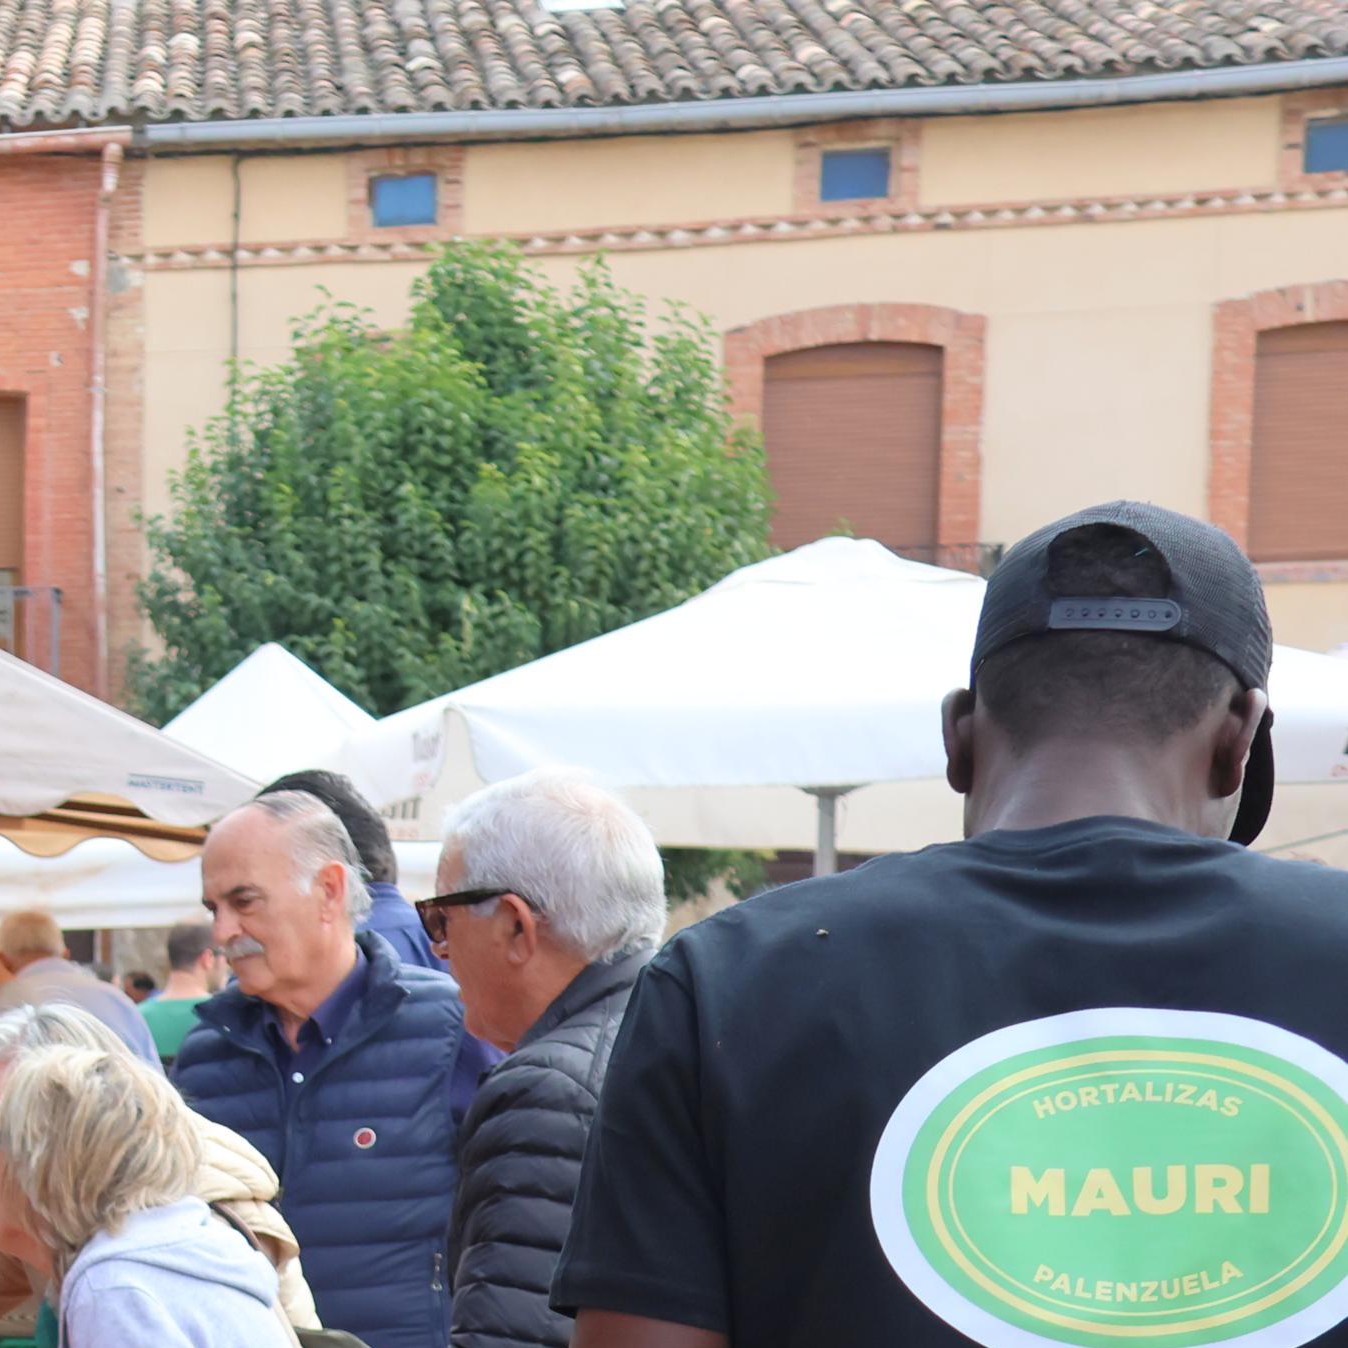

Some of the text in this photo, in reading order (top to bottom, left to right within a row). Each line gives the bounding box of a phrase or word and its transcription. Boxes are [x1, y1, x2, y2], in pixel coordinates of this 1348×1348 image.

[1033, 1082, 1243, 1119] HORTALIZAS
[1011, 1164, 1271, 1216] MAURI
[1034, 1261, 1243, 1302] PALENZUELA
